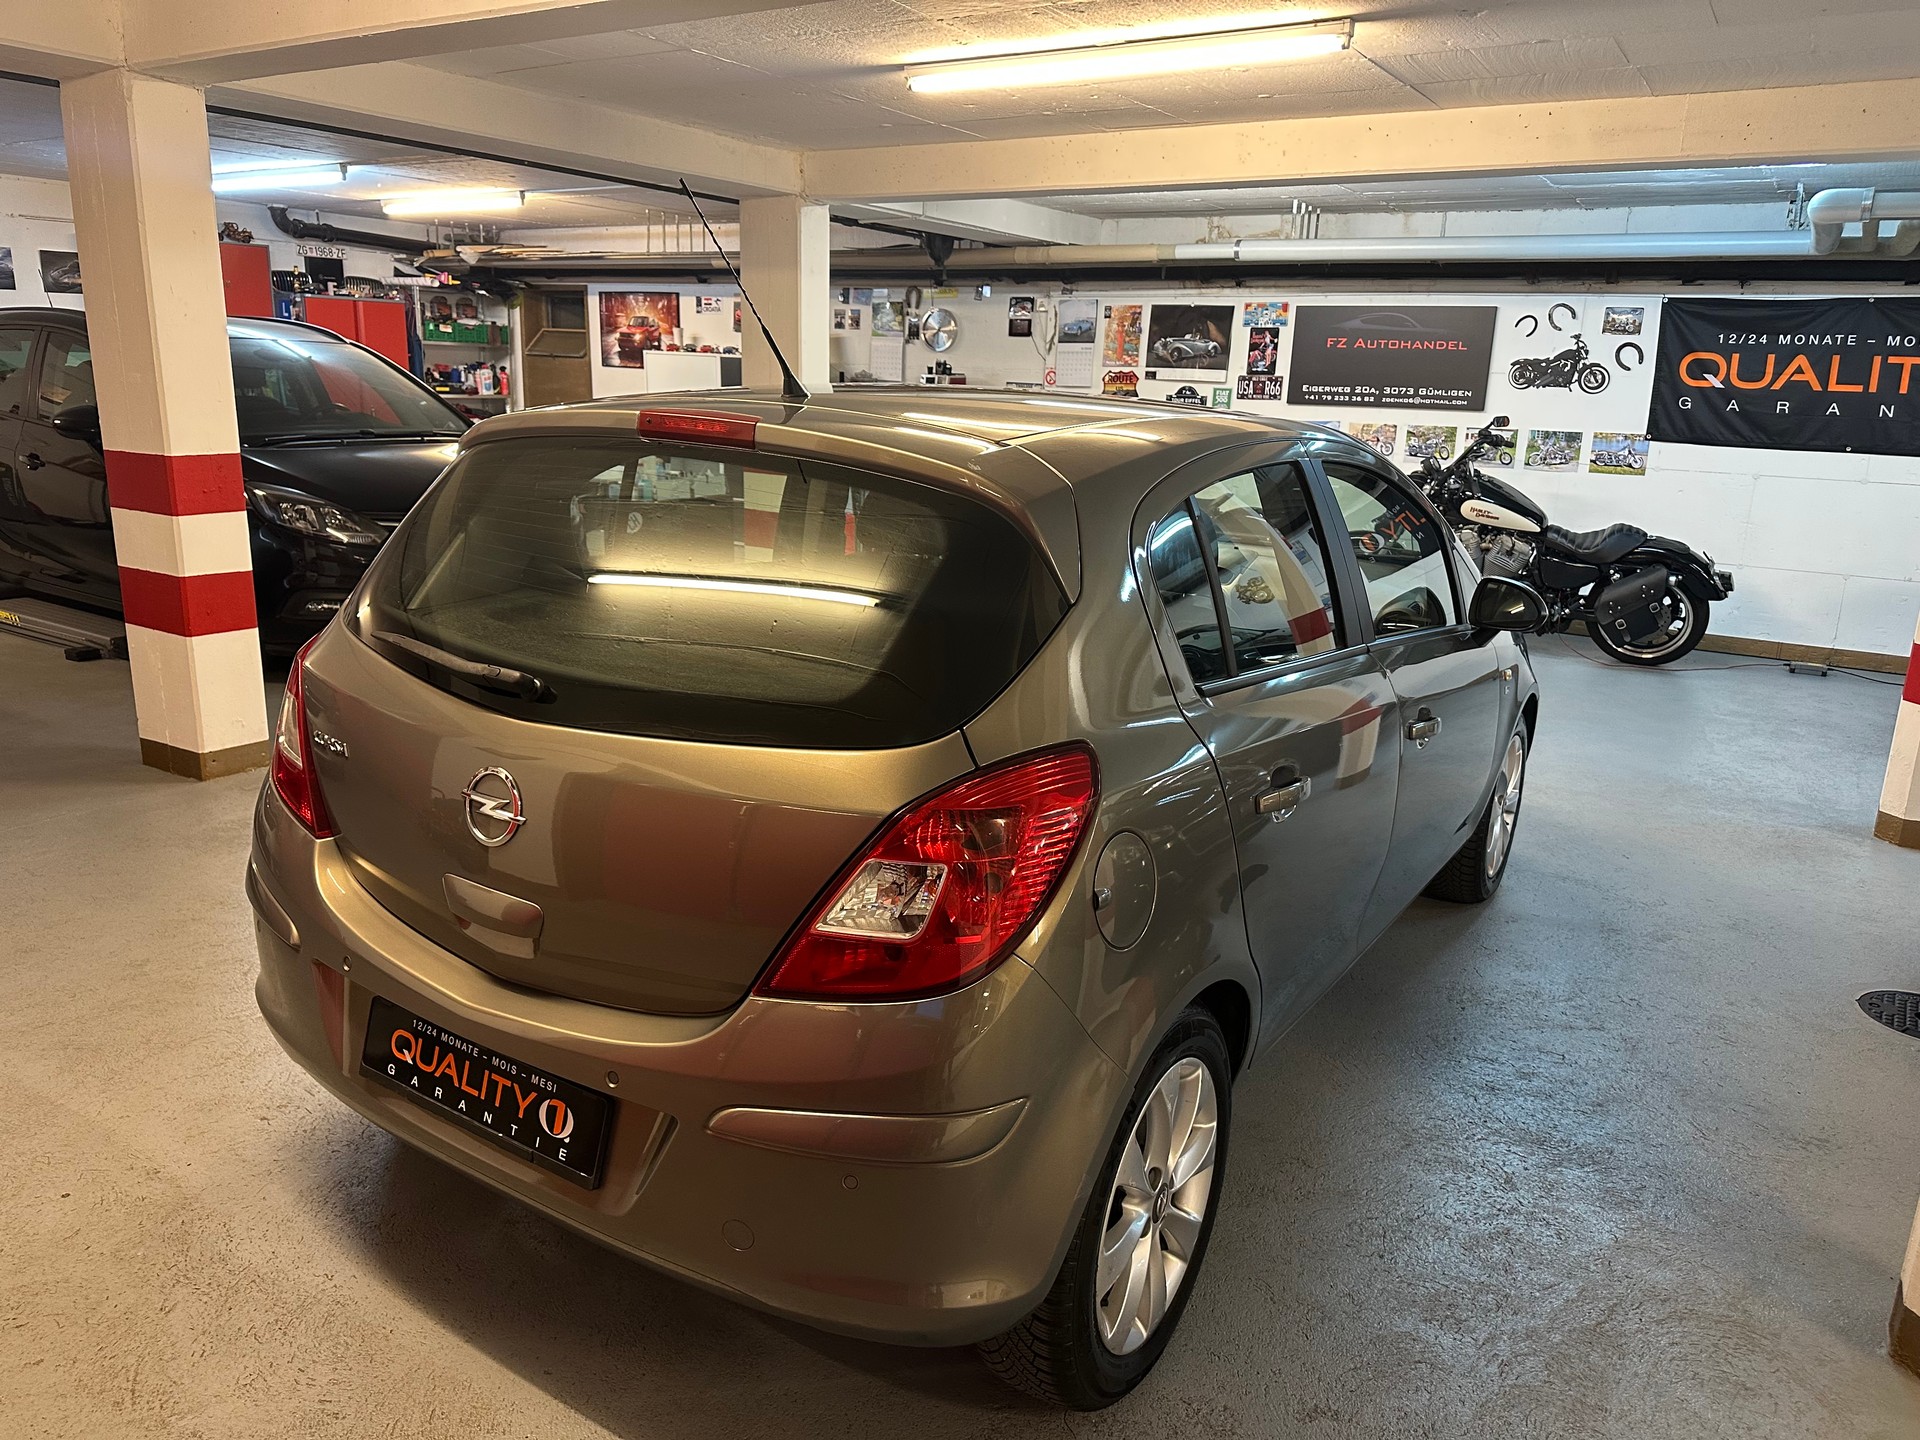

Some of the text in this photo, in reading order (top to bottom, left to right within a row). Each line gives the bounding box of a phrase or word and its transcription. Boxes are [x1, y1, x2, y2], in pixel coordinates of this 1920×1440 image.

[297, 244, 308, 255] ZG
[1326, 337, 1468, 350] FZ AUTOHANDEL
[1717, 333, 1768, 345] 12/24
[1778, 334, 1858, 346] MONATE
[1886, 335, 1920, 347] MO
[1108, 374, 1134, 383] ROUTE
[1238, 380, 1281, 396] USA R66
[1383, 387, 1414, 395] 3073
[1215, 395, 1228, 403] 500
[412, 1019, 438, 1037] 12/24
[440, 1032, 479, 1057] MONATE
[491, 1056, 517, 1075] MOIS
[531, 1075, 558, 1093] MESI
[391, 1029, 538, 1119] QUALITY
[387, 1064, 568, 1161] GARANTIE
